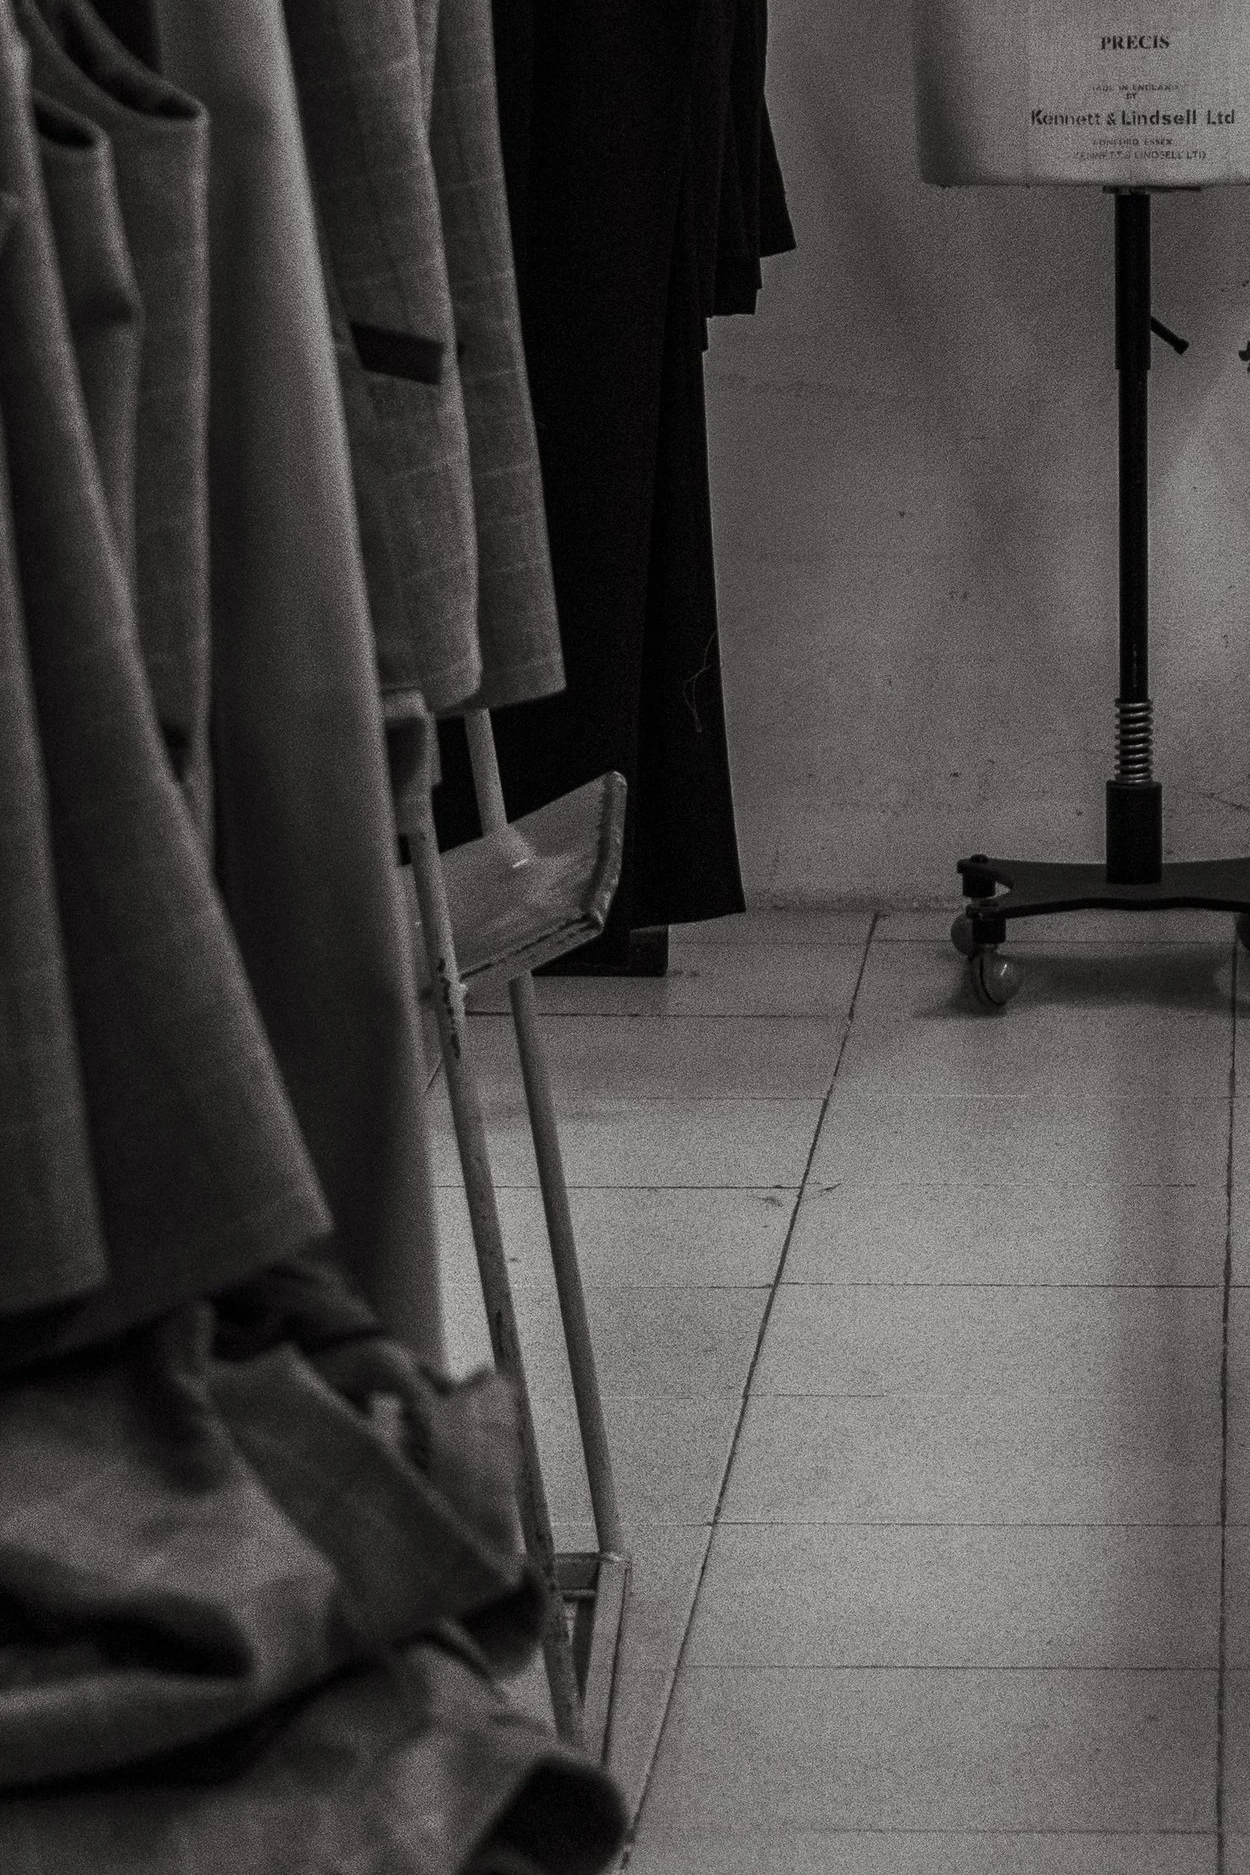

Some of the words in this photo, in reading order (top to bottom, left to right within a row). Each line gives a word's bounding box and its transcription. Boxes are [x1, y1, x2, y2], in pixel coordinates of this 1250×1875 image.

[1101, 34, 1170, 50] PRECIS
[1031, 109, 1101, 126] Kennett
[1106, 112, 1117, 126] &
[1121, 109, 1197, 126] Lindsell
[1206, 109, 1236, 125] Ltd
